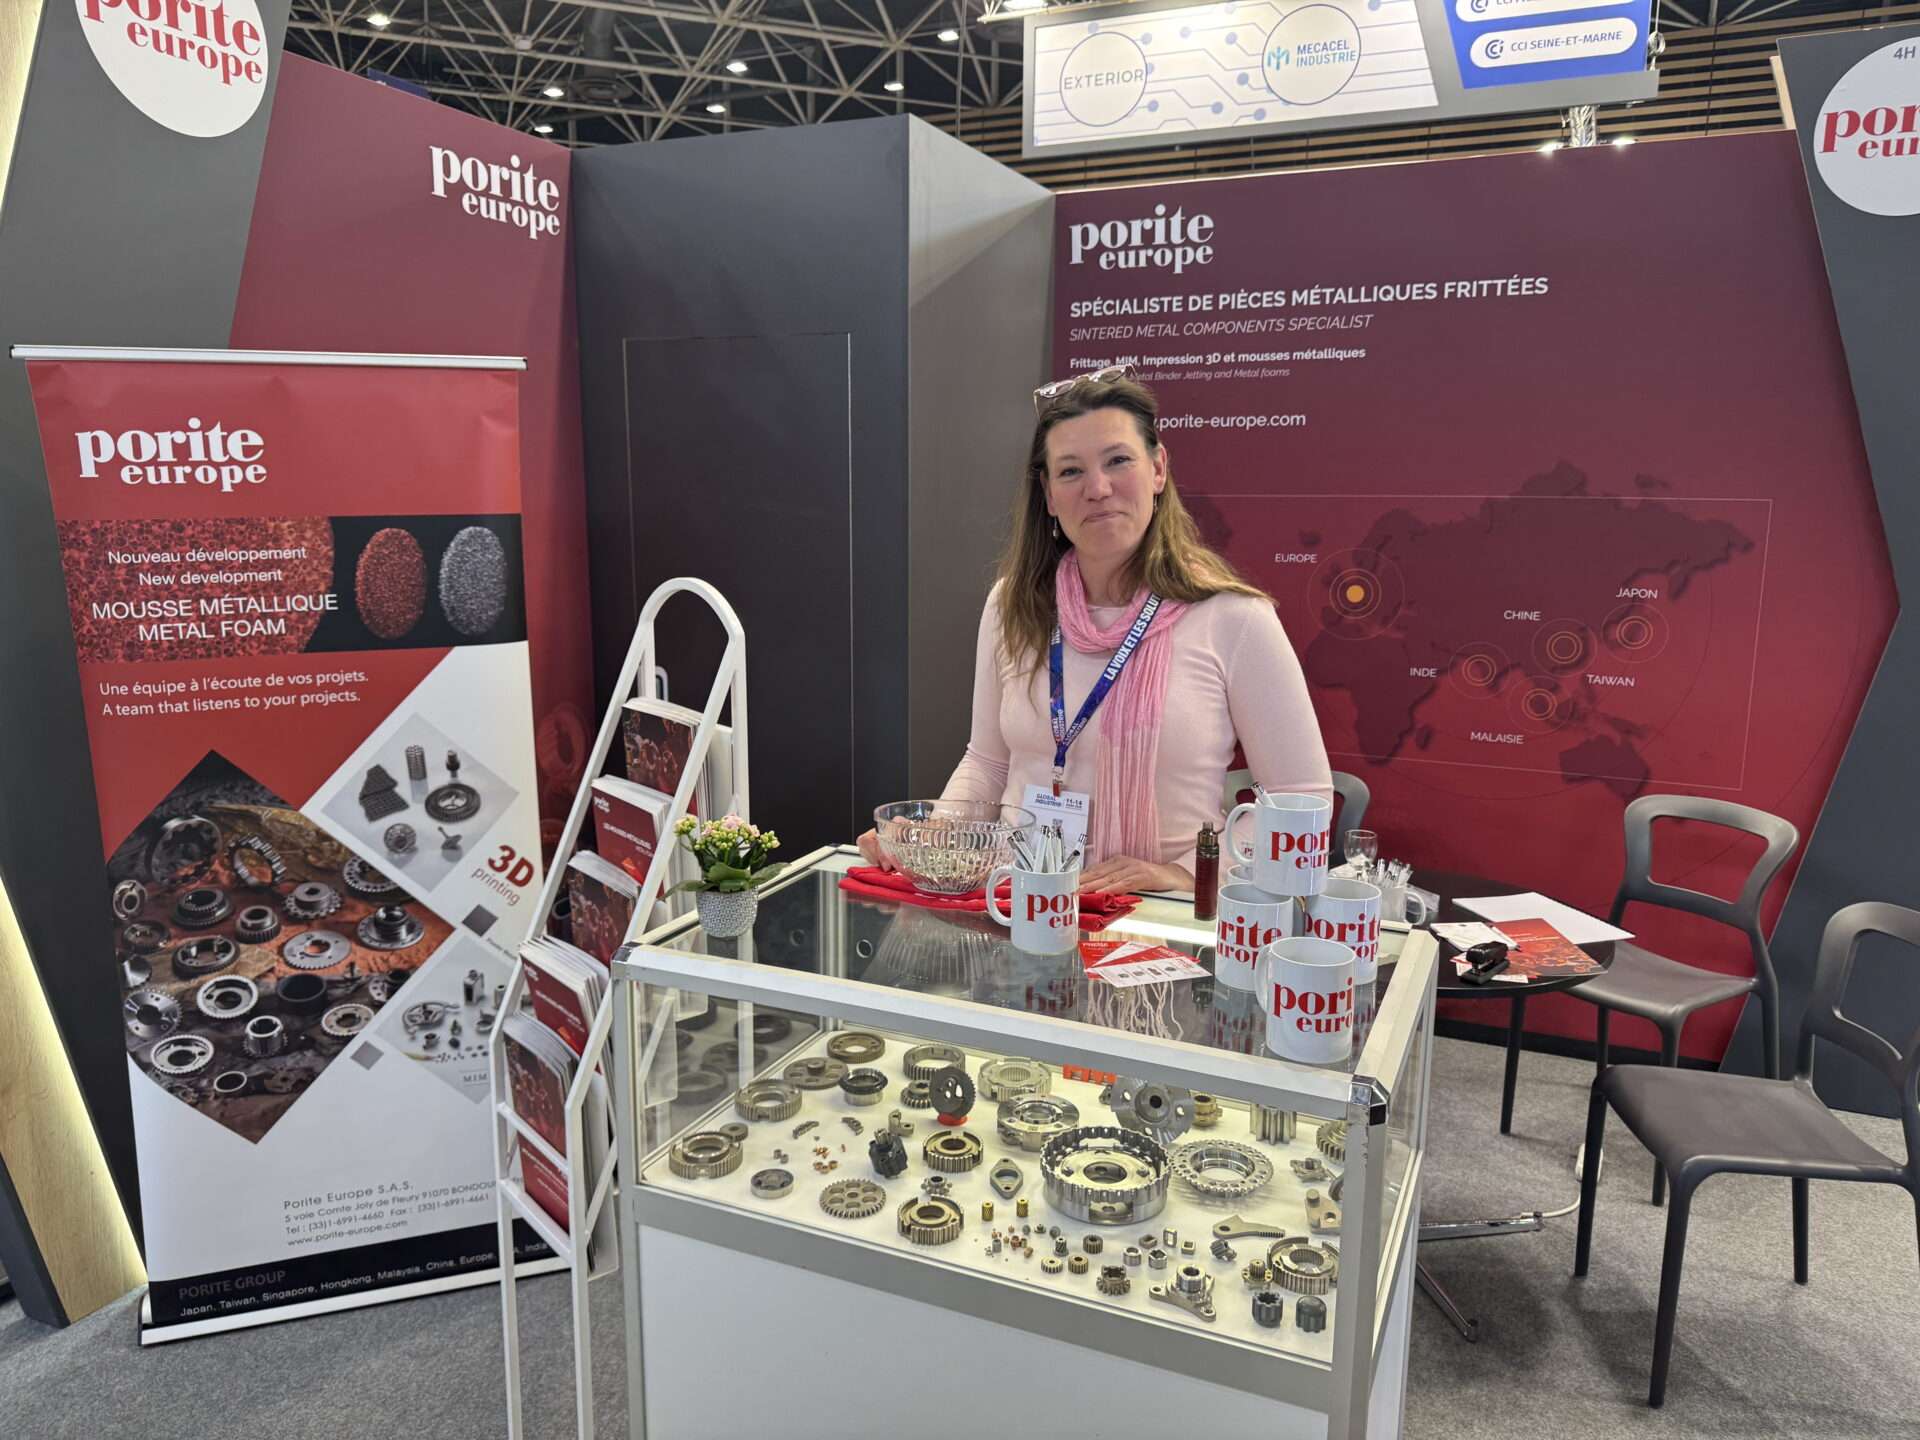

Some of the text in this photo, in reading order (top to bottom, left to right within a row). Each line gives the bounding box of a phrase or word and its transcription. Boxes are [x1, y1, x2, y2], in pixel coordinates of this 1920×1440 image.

[1297, 39, 1350, 55] MECACEL
[1511, 31, 1623, 52] CCI SEINE-ET-MARNE
[127, 22, 263, 86] europe
[1296, 50, 1357, 68] INDUSTRIE
[1893, 46, 1917, 60] 4H
[1064, 69, 1144, 90] EXTERIOR
[429, 145, 560, 211] porite
[462, 192, 560, 240] europe
[1069, 204, 1215, 264] porite
[1099, 244, 1214, 274] europe
[1070, 296, 1183, 318] SPÉCIALISTE
[1188, 295, 1214, 311] DE
[1291, 284, 1438, 306] MÉTALLIQUES
[1443, 274, 1549, 299] FRITTÉES
[1069, 314, 1375, 341] SINTERED METAL COMPONENTS SPECIALIST
[1142, 353, 1205, 368] Impression
[1206, 353, 1221, 365] 3D
[1223, 354, 1236, 363] et
[1238, 351, 1290, 363] mousses
[1293, 347, 1366, 361] métalliques
[1214, 368, 1232, 379] and
[1234, 367, 1260, 378] Metal
[1260, 367, 1291, 380] foams
[74, 417, 264, 477] porite
[119, 463, 267, 491] europe
[108, 547, 307, 565] Nouveau développement
[1274, 553, 1318, 564] EUROPE
[139, 569, 282, 587] New development
[1616, 587, 1658, 600] JAPON
[92, 594, 339, 620] MOUSSE MÉTALLIQUE
[1504, 610, 1541, 621] CHINE
[139, 618, 286, 641] METAL FOAM
[1131, 619, 1148, 639] LES
[1124, 634, 1139, 649] ET
[1110, 646, 1132, 668] VOIX
[1409, 667, 1437, 678] INDE
[1586, 674, 1635, 687] TAIWAN
[100, 682, 129, 696] Une
[133, 679, 186, 698] équipe
[190, 679, 199, 692] à
[265, 673, 284, 686] de
[287, 675, 313, 685] vos
[316, 670, 369, 687] projets.
[103, 691, 361, 716] A team that listens to your projects.
[1470, 731, 1524, 744] MALAISIE
[487, 844, 534, 888] 3D
[471, 866, 521, 906] printing
[1218, 916, 1282, 948] rite
[1305, 912, 1381, 943] orit
[283, 1196, 322, 1210] Porite
[327, 1188, 373, 1203] Europe
[376, 1198, 389, 1207] de
[179, 1270, 287, 1300] PORITE GROUP
